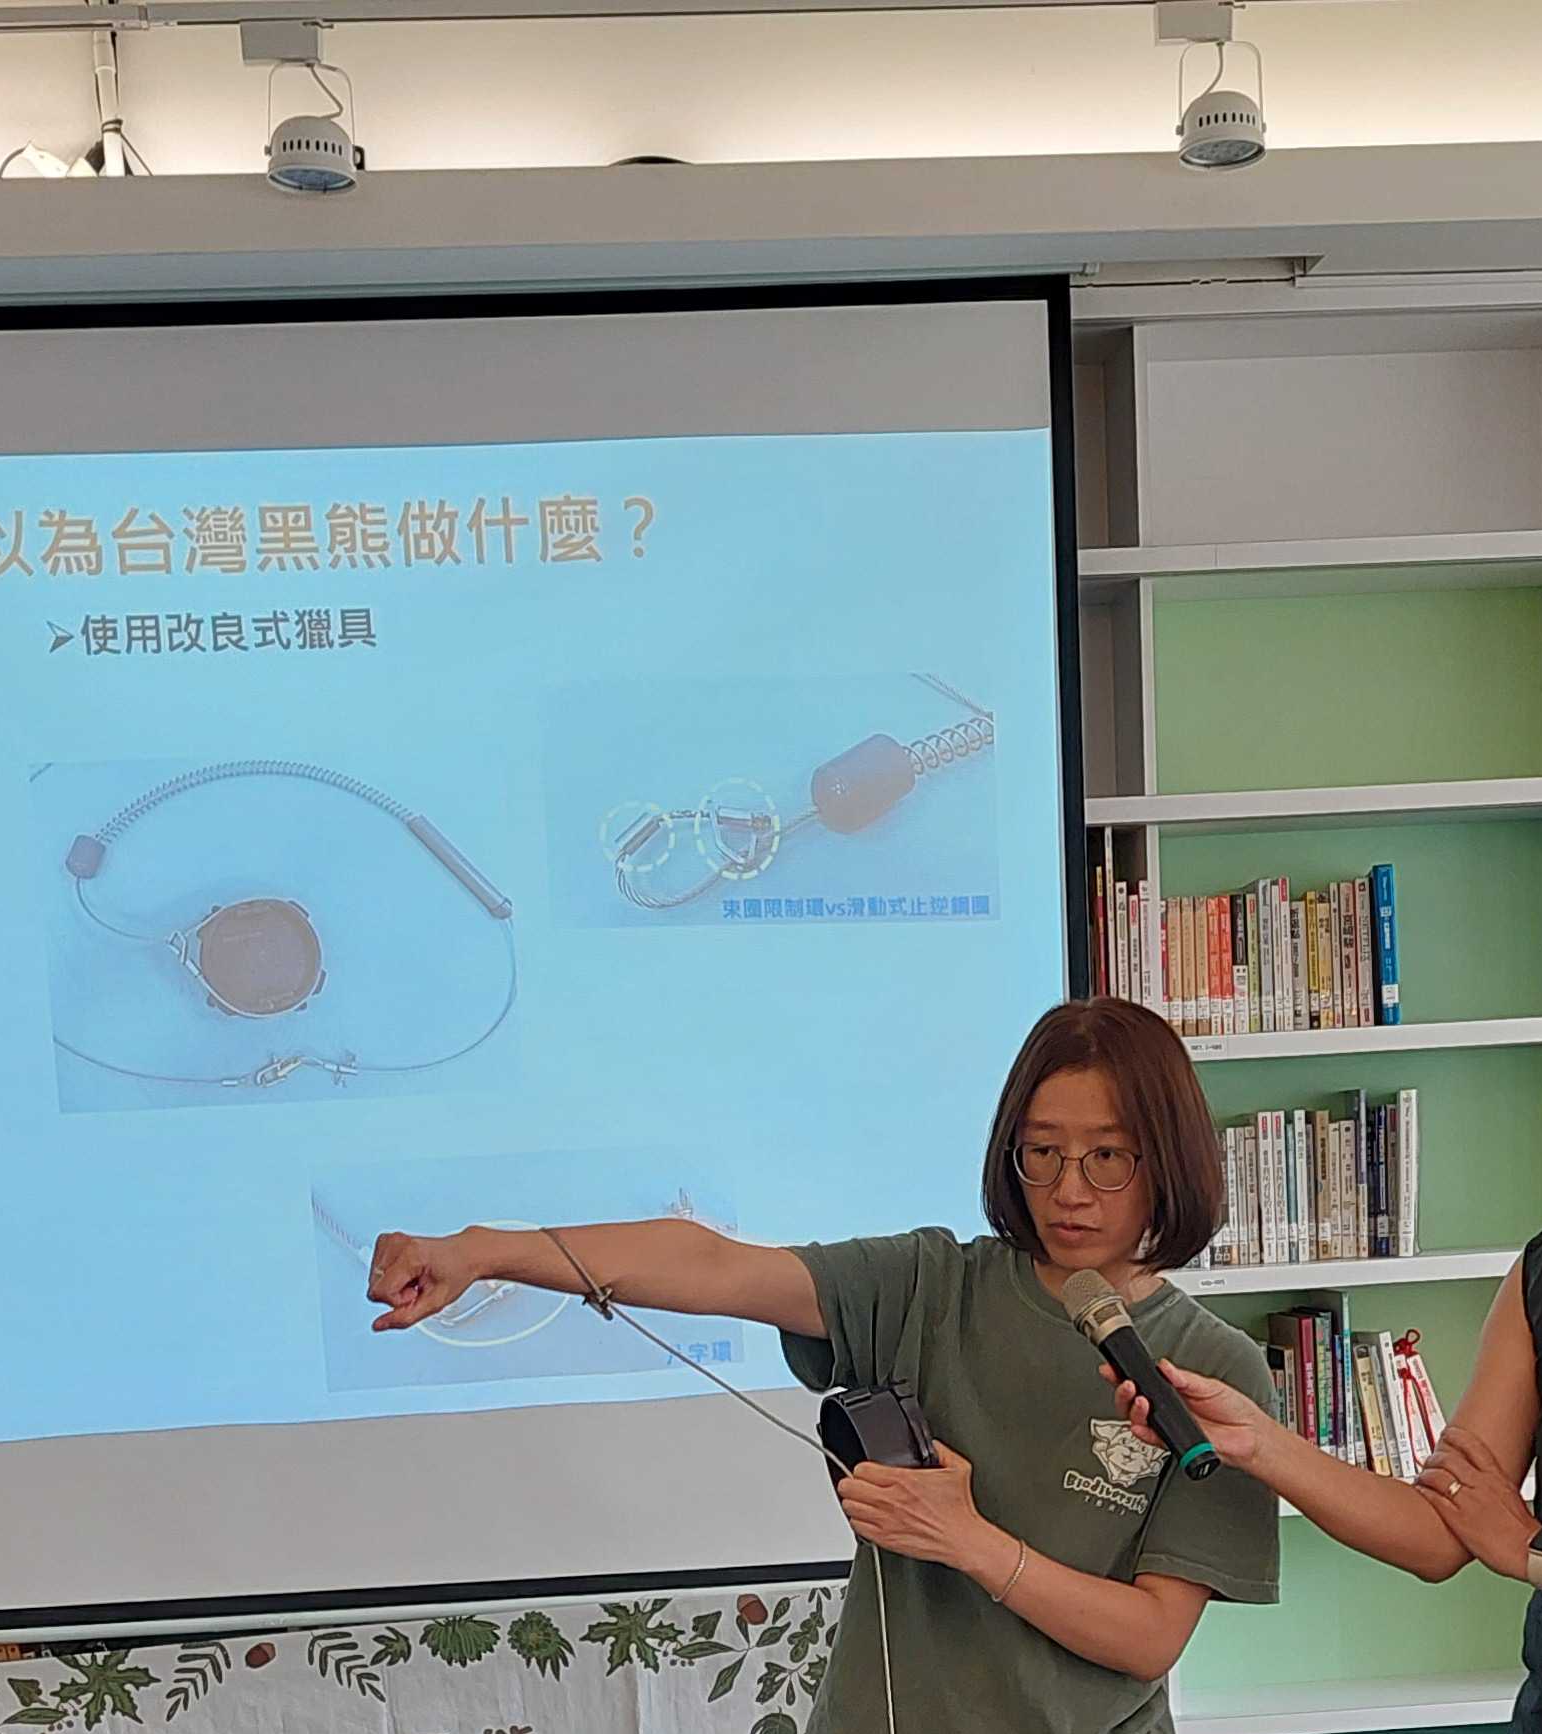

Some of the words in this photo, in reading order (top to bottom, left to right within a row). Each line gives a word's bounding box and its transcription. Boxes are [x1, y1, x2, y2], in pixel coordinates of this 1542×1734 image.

[80, 608, 376, 655] 使用改良式獵具
